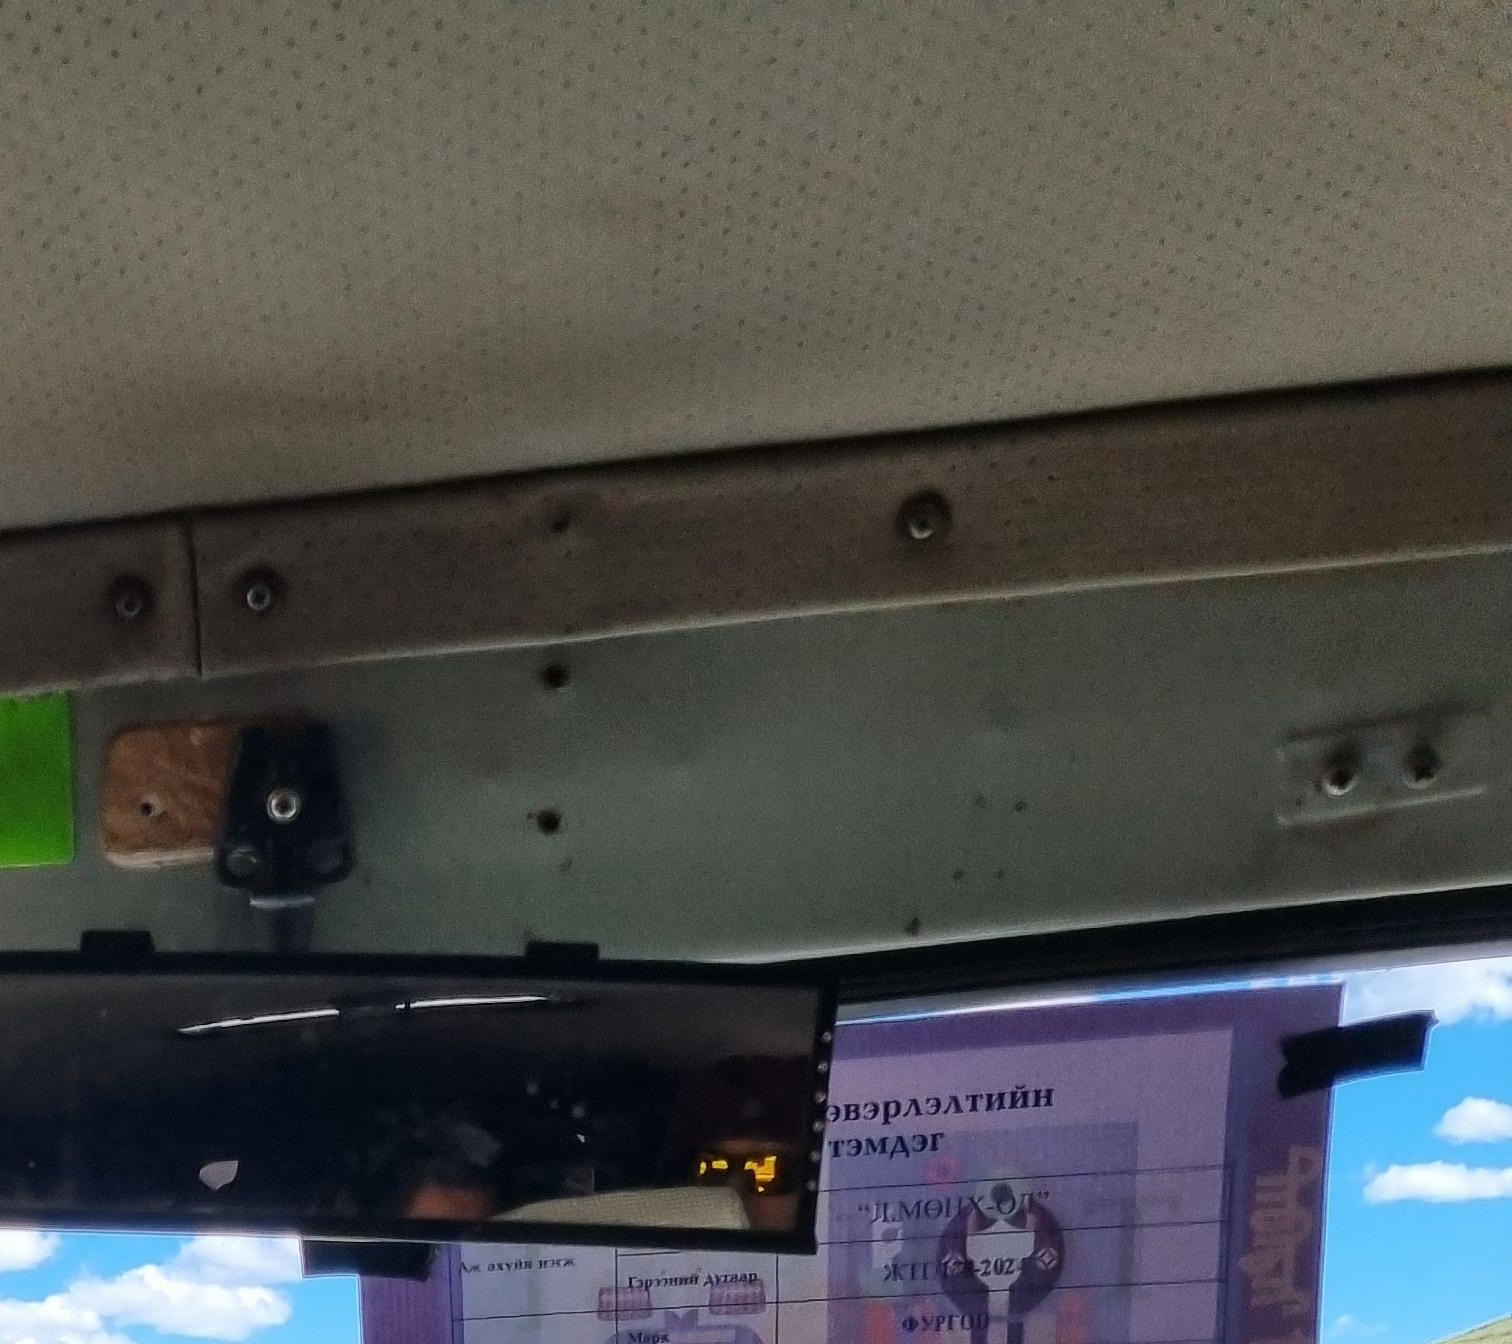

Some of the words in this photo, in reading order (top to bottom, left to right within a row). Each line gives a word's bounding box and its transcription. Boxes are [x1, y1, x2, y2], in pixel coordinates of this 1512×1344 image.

[828, 1132, 945, 1160] тэмдэг
[627, 1273, 699, 1290] Гэрээний
[703, 1270, 759, 1288] дугаар
[628, 1332, 670, 1344] Марк
